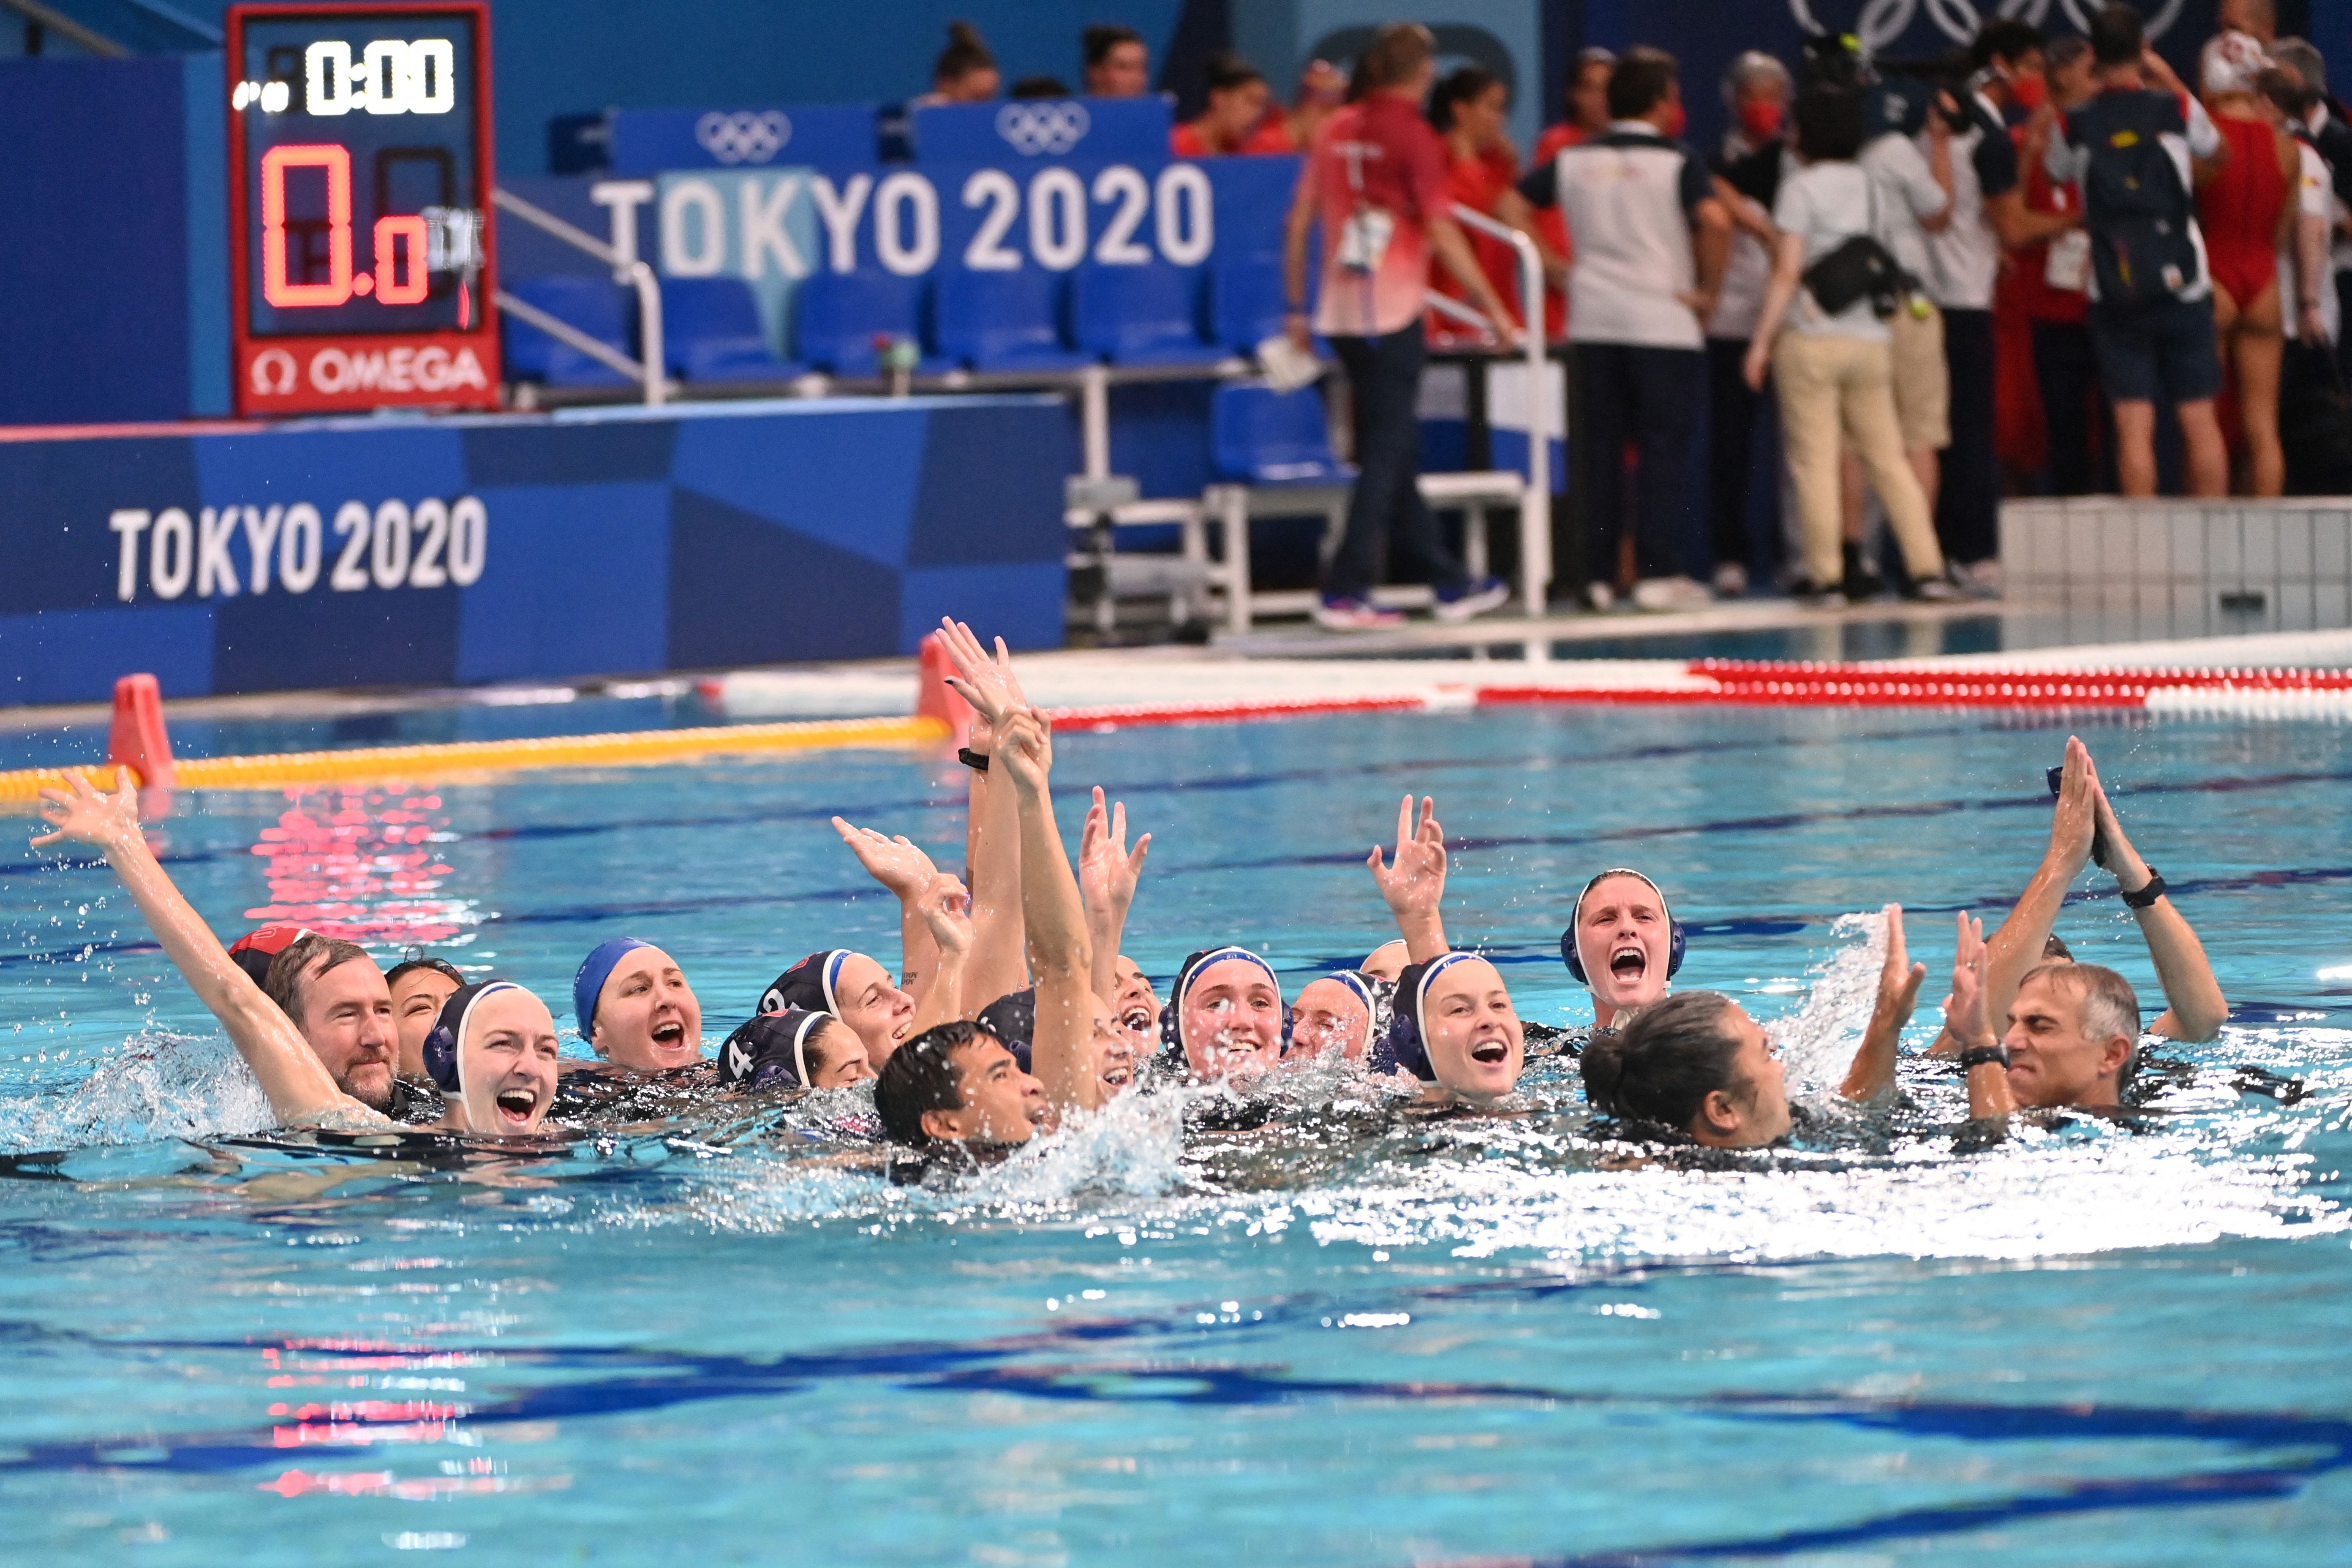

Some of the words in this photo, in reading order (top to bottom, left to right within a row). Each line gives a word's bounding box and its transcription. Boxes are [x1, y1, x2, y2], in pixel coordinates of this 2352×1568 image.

[305, 39, 455, 115] 0:00
[261, 144, 428, 307] 0.0
[590, 171, 940, 280] TOKYO
[961, 163, 1214, 271] 2020
[309, 347, 487, 394] OMEGA
[109, 501, 323, 601] TOKYO
[329, 495, 488, 592] 2020
[729, 1039, 754, 1080] 4
